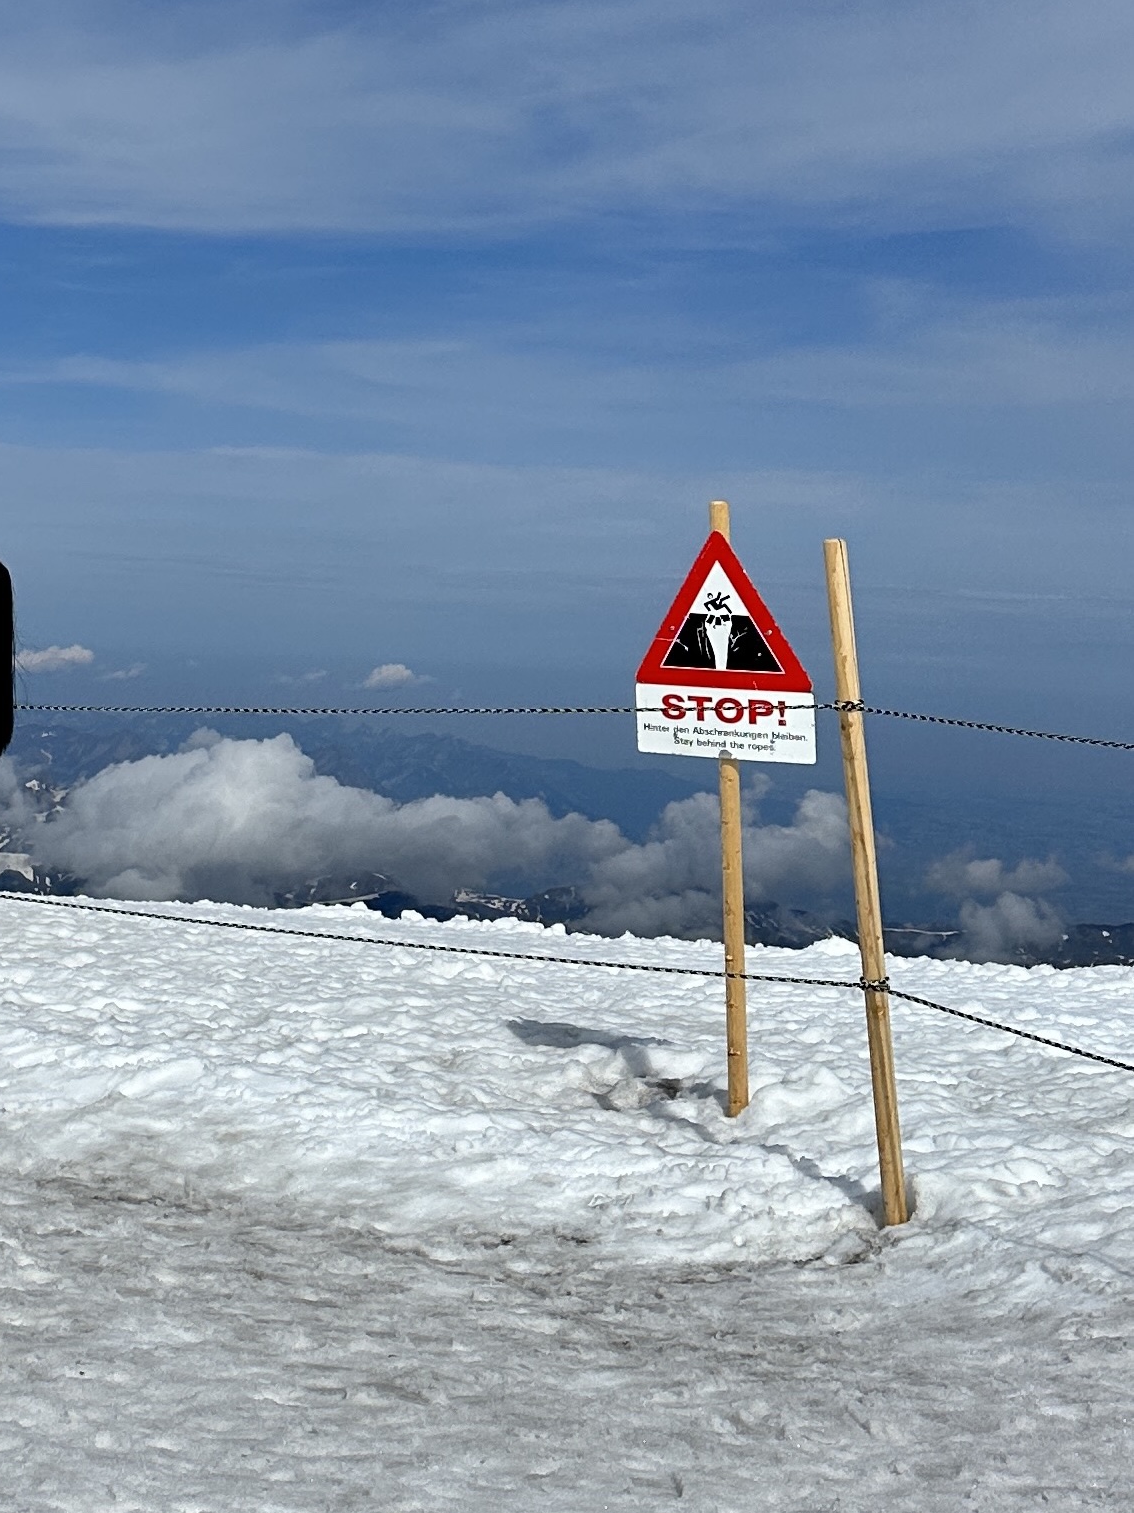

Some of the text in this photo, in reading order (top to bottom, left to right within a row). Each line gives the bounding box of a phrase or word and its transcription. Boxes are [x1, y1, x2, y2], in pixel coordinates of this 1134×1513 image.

[661, 694, 787, 726] STOP!
[643, 723, 670, 732] Hinter
[673, 726, 689, 734] den
[693, 727, 768, 740] Abschrankungen
[674, 737, 693, 747] Stay
[697, 738, 726, 748] behind
[730, 740, 745, 750] the
